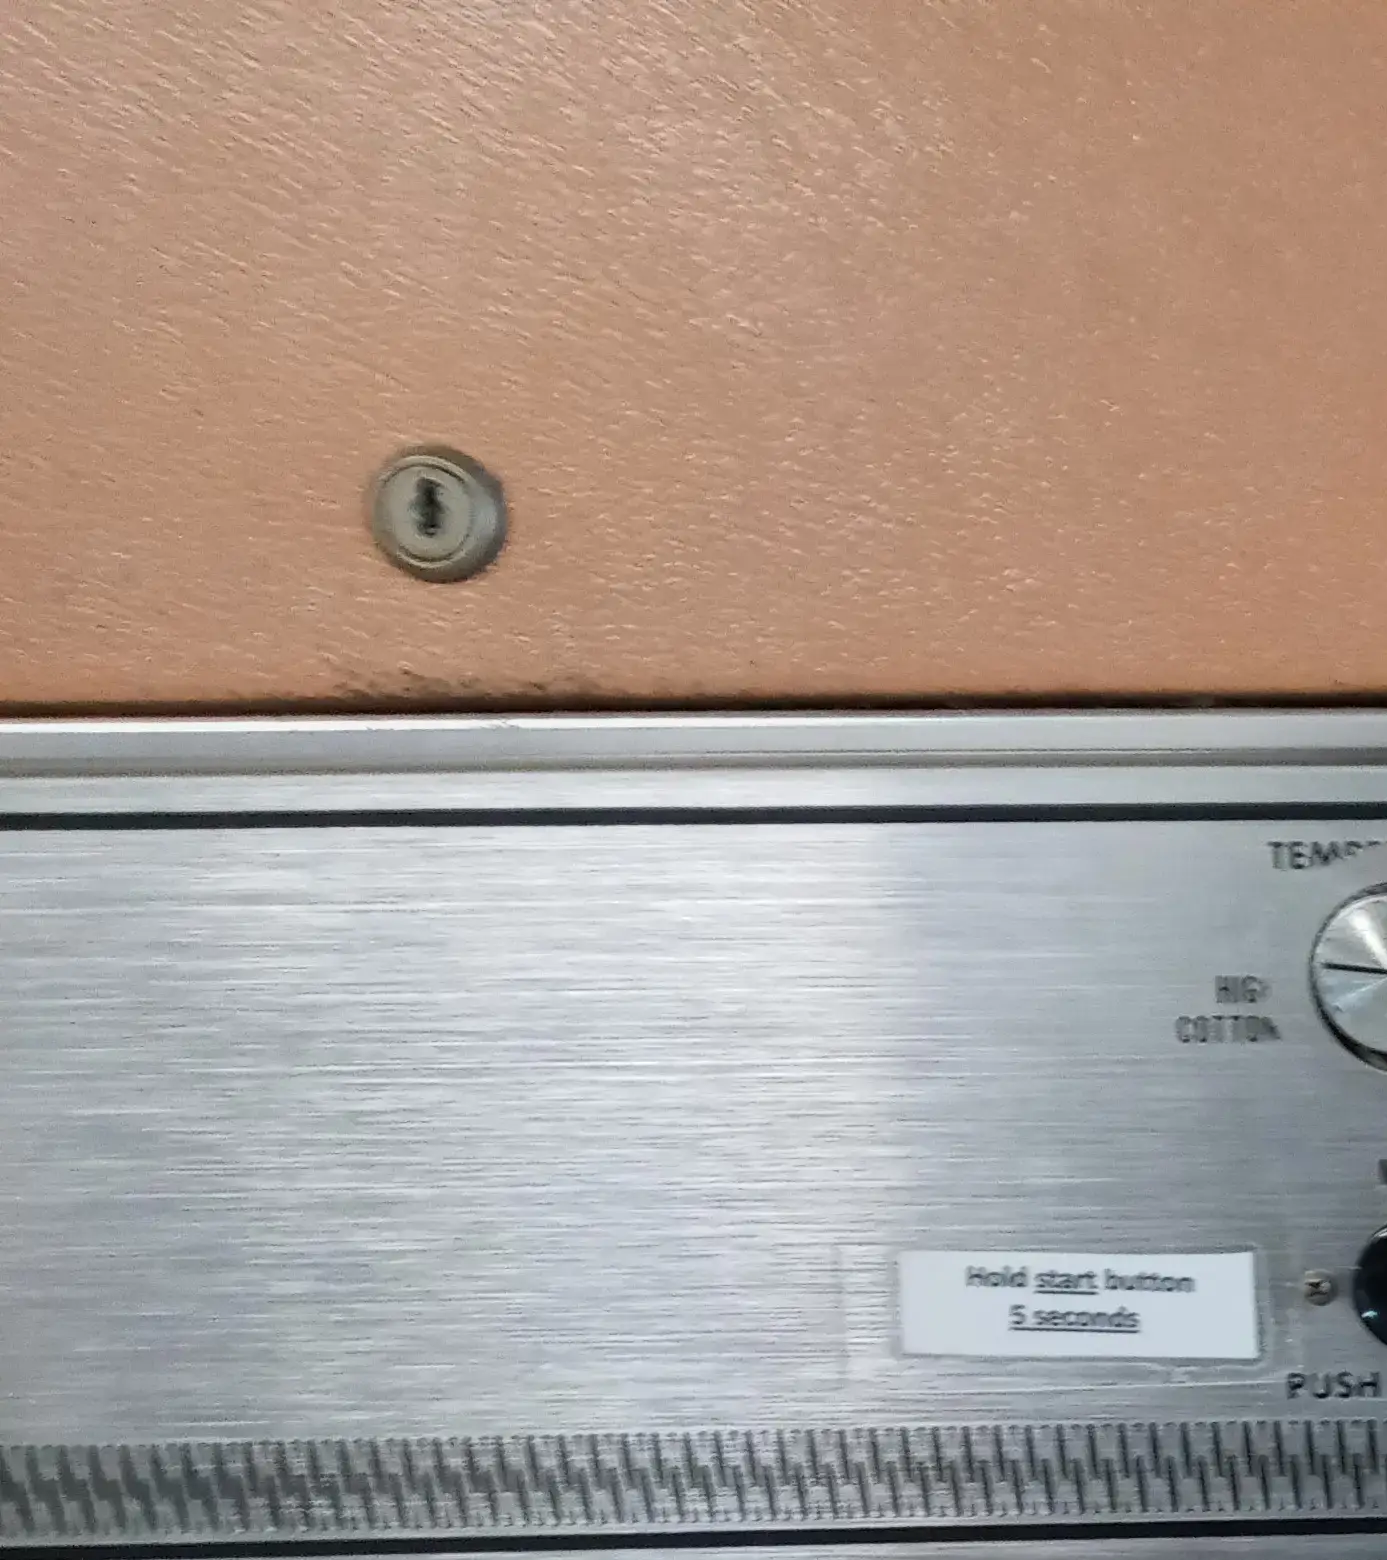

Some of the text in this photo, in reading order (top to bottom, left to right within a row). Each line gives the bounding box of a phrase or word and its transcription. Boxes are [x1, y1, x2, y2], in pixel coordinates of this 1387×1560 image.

[966, 1265, 1196, 1293] Hold start button
[1008, 1304, 1141, 1329] 5 seconds
[1286, 1371, 1382, 1400] PUSH
